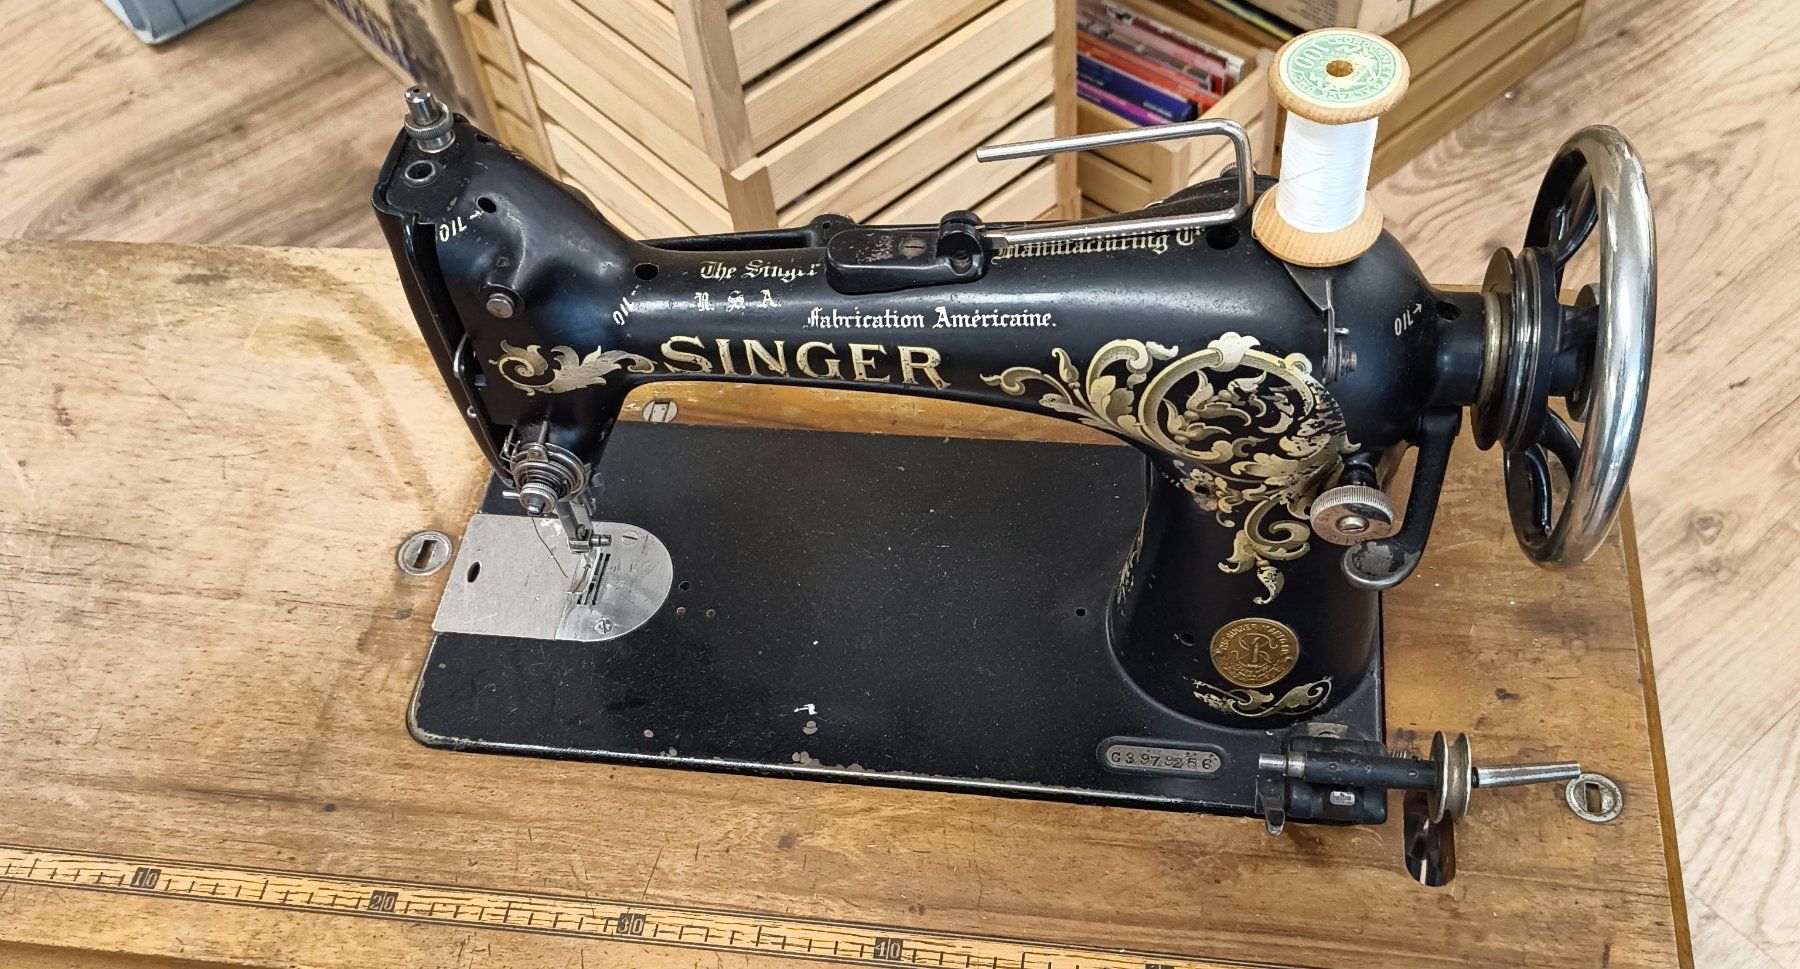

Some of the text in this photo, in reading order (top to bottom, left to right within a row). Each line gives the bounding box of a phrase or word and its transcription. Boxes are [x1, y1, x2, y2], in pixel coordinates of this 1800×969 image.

[1294, 42, 1330, 69] 100
[439, 215, 468, 242] OIL
[700, 260, 738, 282] The
[612, 296, 635, 326] OIL
[806, 305, 1057, 329] Fabrication Américaine.
[1394, 309, 1414, 336] OIL
[660, 335, 952, 391] SINGER
[132, 869, 160, 889] 10
[369, 893, 396, 911] 20
[875, 939, 902, 960] 40
